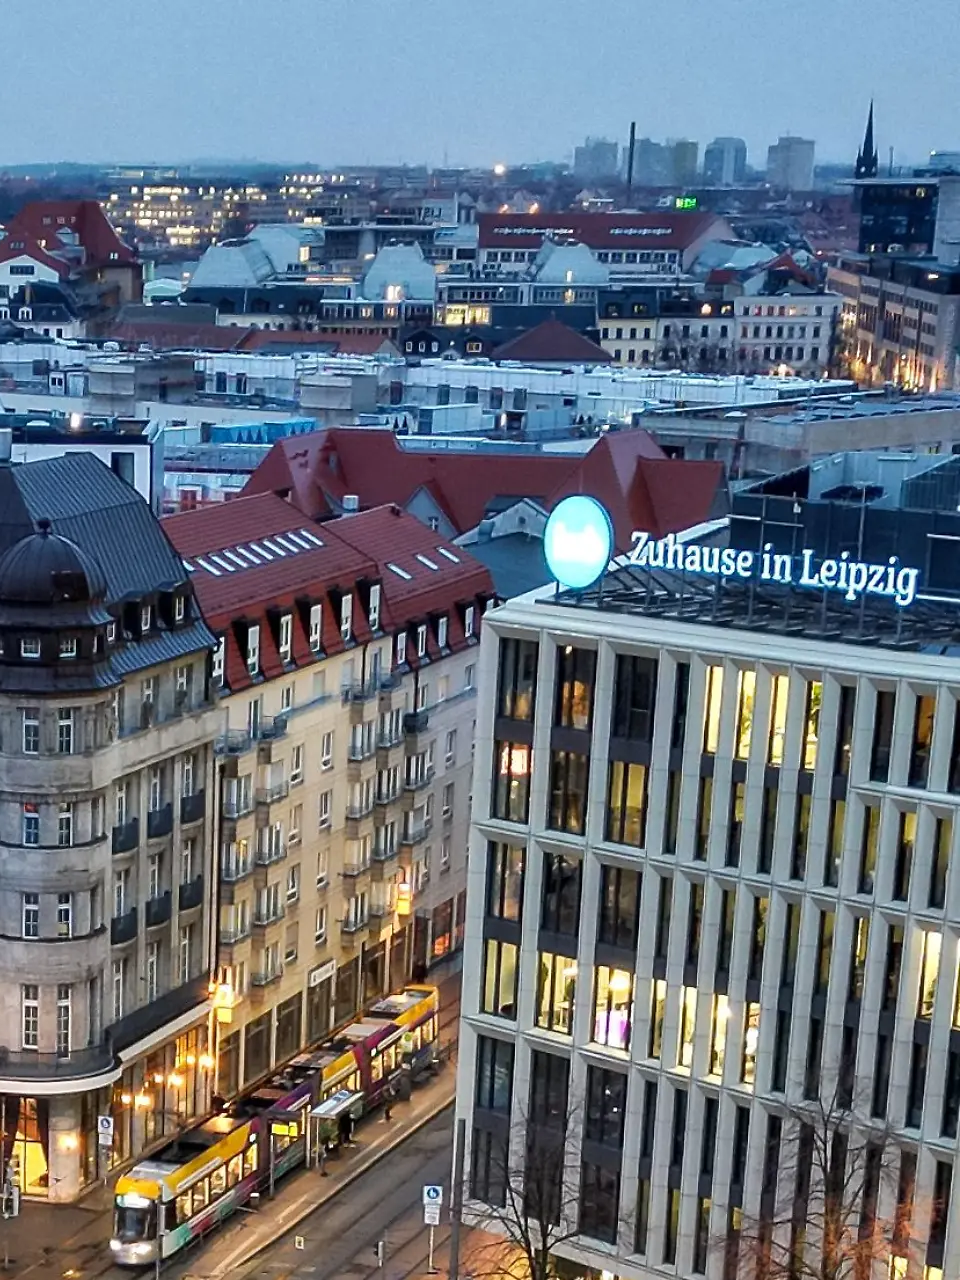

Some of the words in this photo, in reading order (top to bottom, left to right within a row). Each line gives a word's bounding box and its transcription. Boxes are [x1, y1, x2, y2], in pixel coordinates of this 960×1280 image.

[630, 531, 752, 577] Zuhause
[761, 543, 792, 581] in
[801, 549, 919, 606] Leipzig
